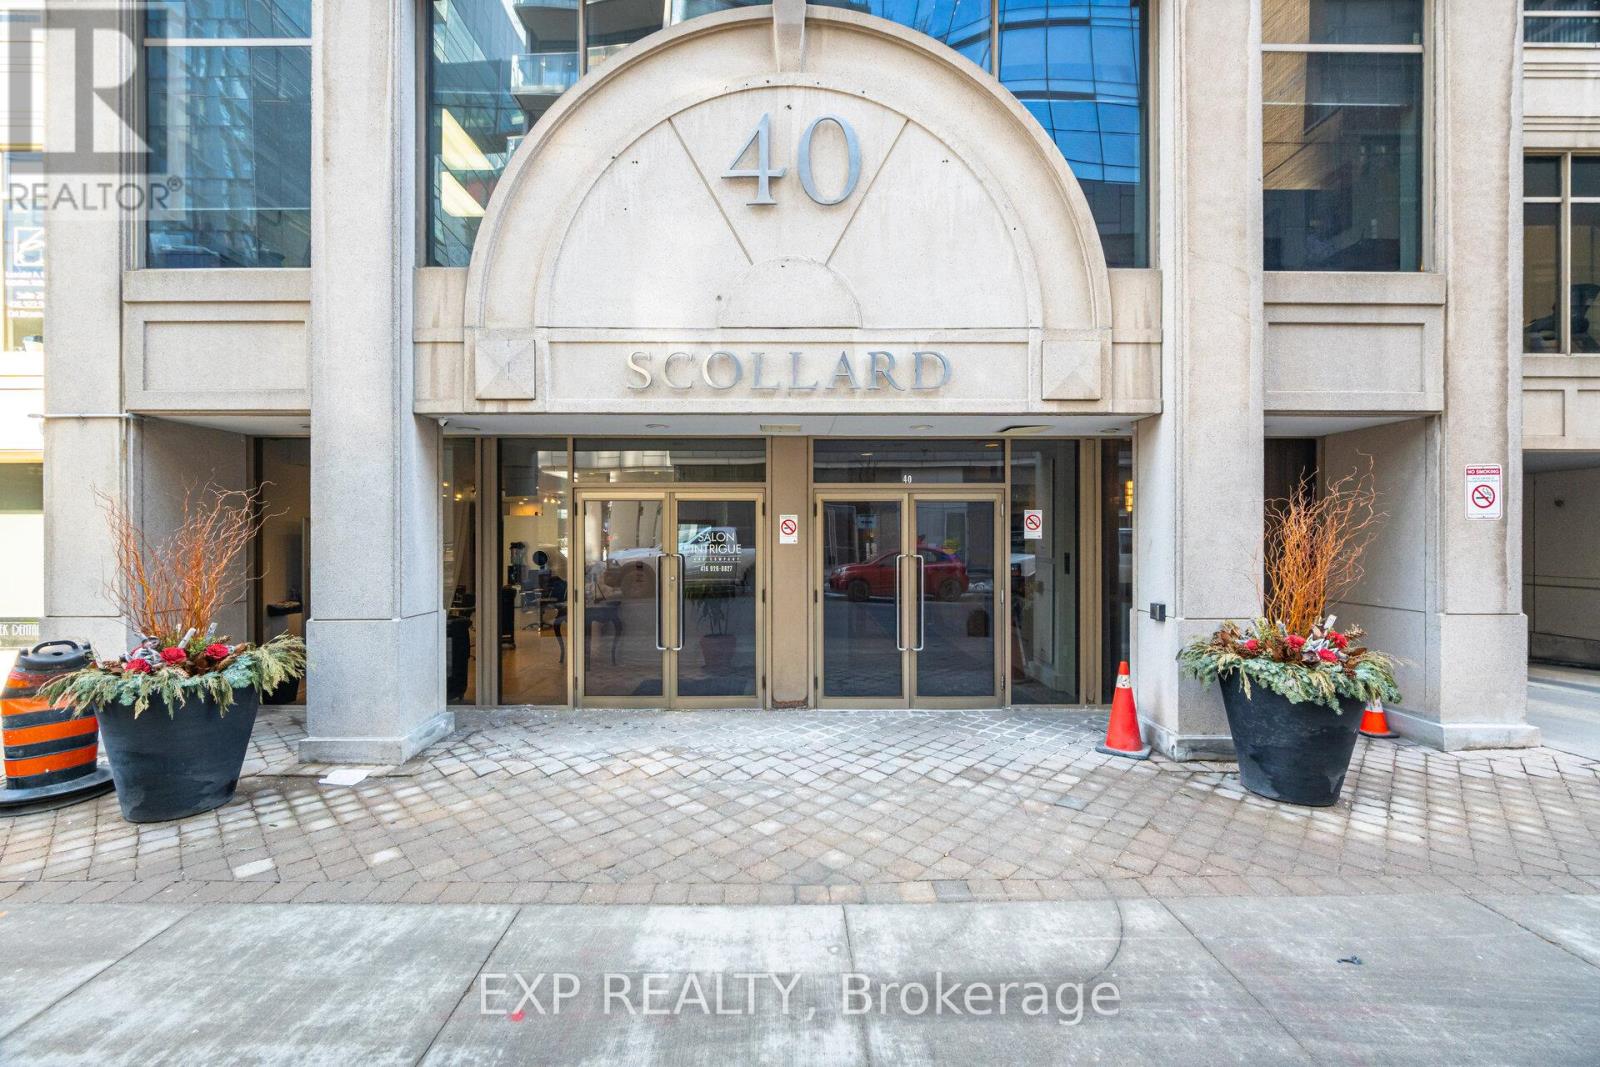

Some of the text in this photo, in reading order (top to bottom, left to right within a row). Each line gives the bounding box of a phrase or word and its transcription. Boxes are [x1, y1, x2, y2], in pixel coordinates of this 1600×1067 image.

[721, 112, 862, 207] 40
[627, 350, 952, 391] SCOLLARD
[903, 475, 912, 483] 40
[698, 532, 735, 542] SALON
[690, 543, 742, 554] INTRIGUE
